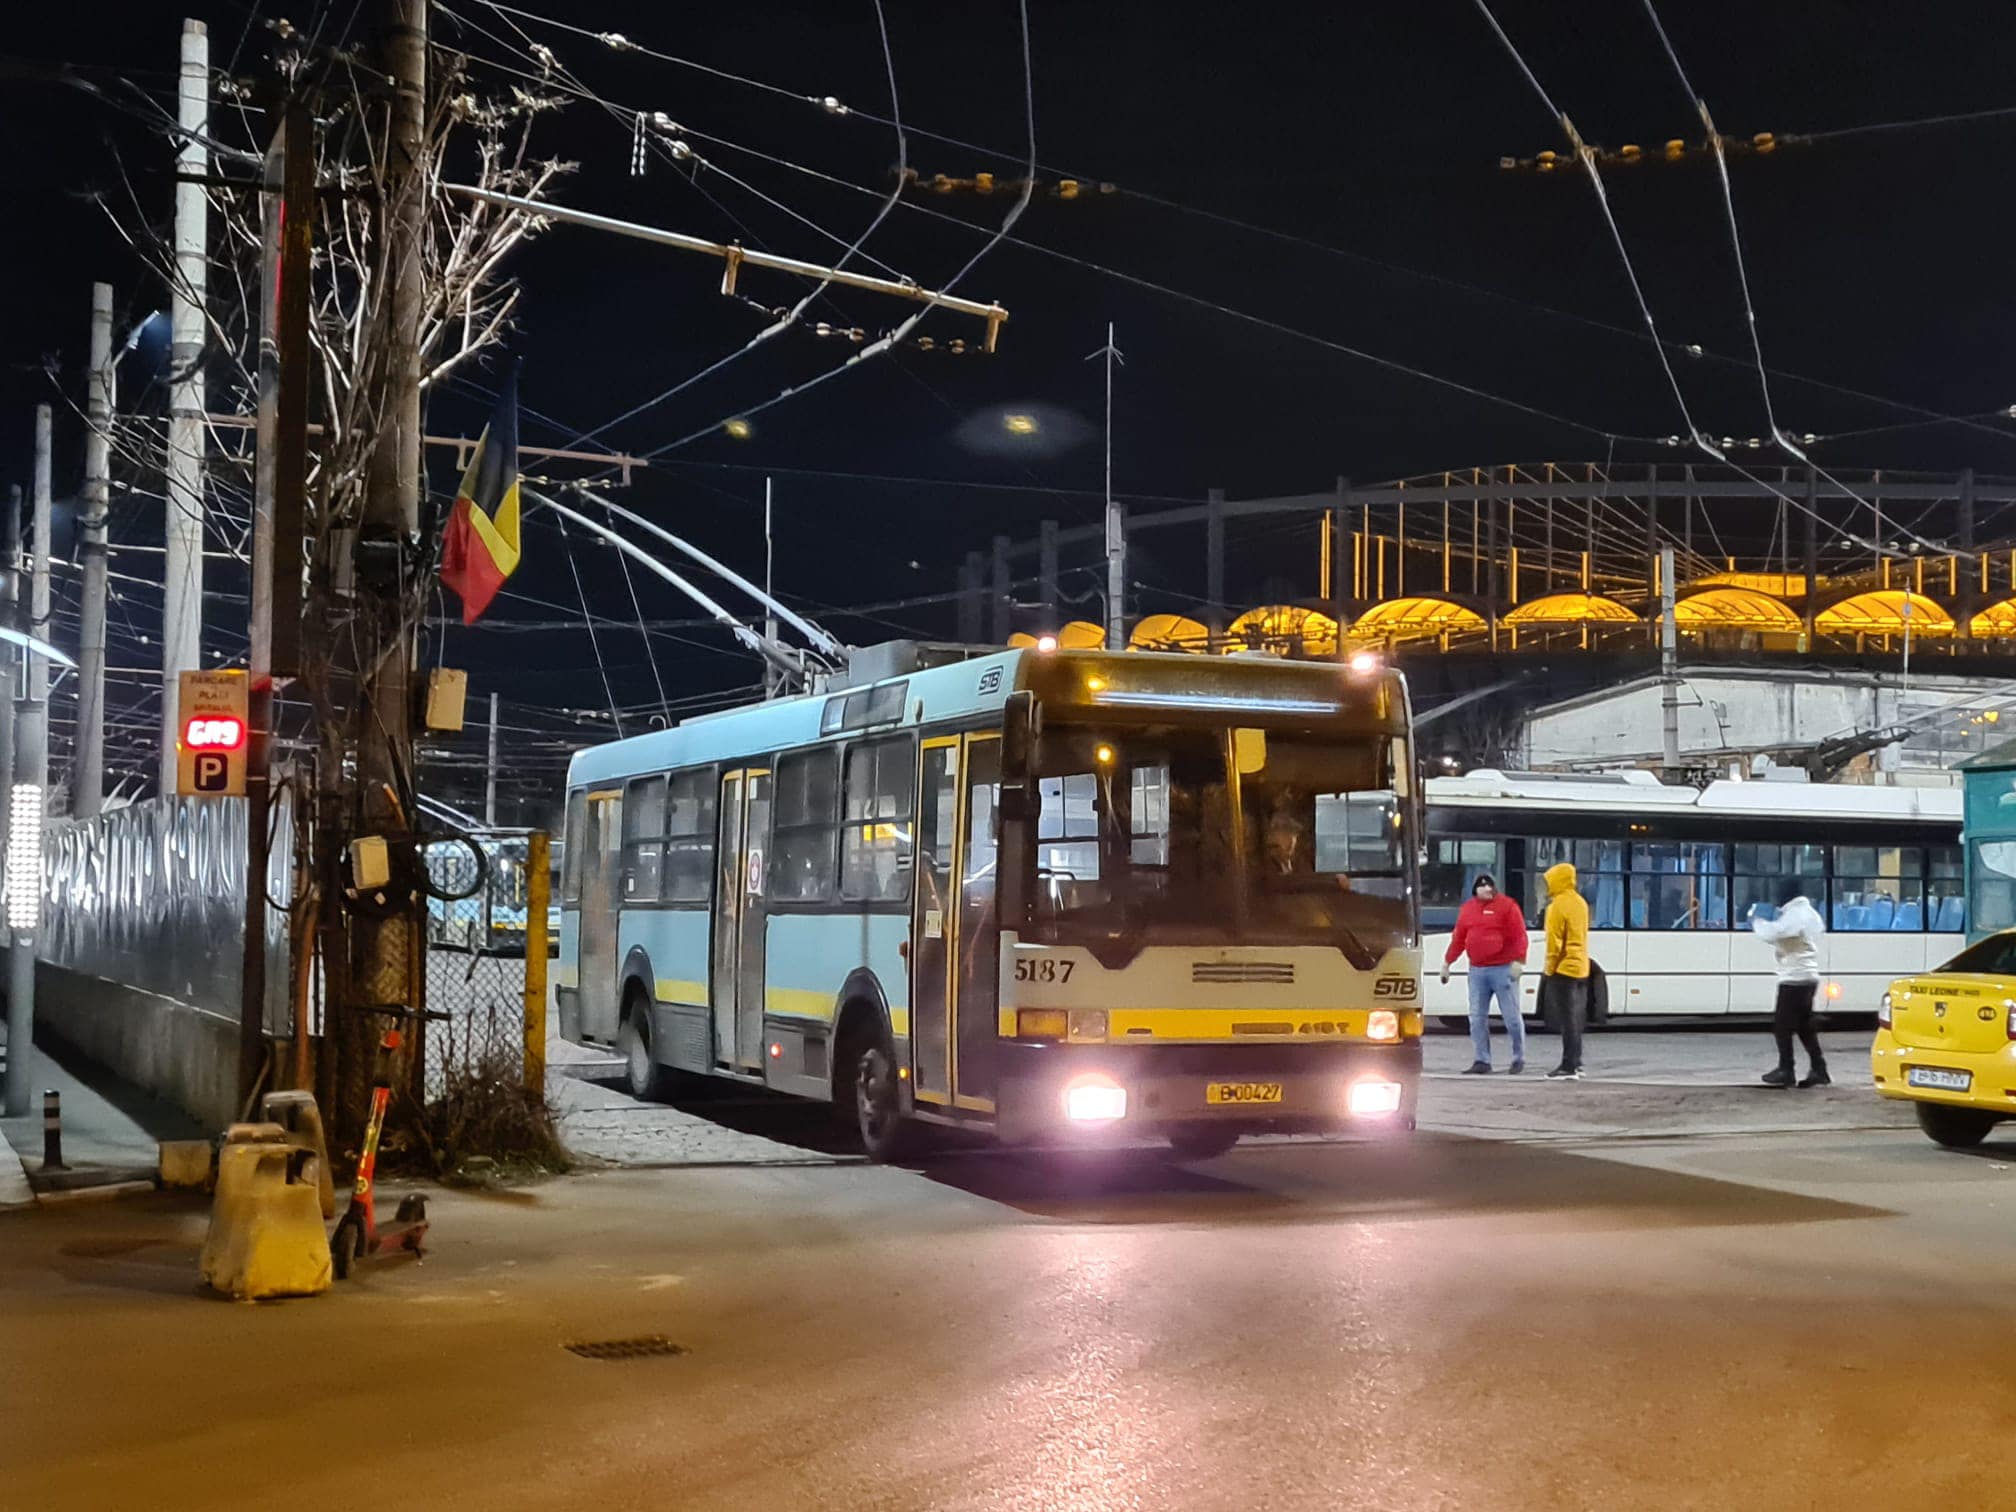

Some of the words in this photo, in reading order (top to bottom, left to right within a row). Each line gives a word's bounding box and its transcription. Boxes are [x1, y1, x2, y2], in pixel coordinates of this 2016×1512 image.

[978, 670, 1001, 691] STB
[199, 757, 223, 787] P
[1014, 958, 1076, 984] 5187
[1373, 977, 1416, 995] STB
